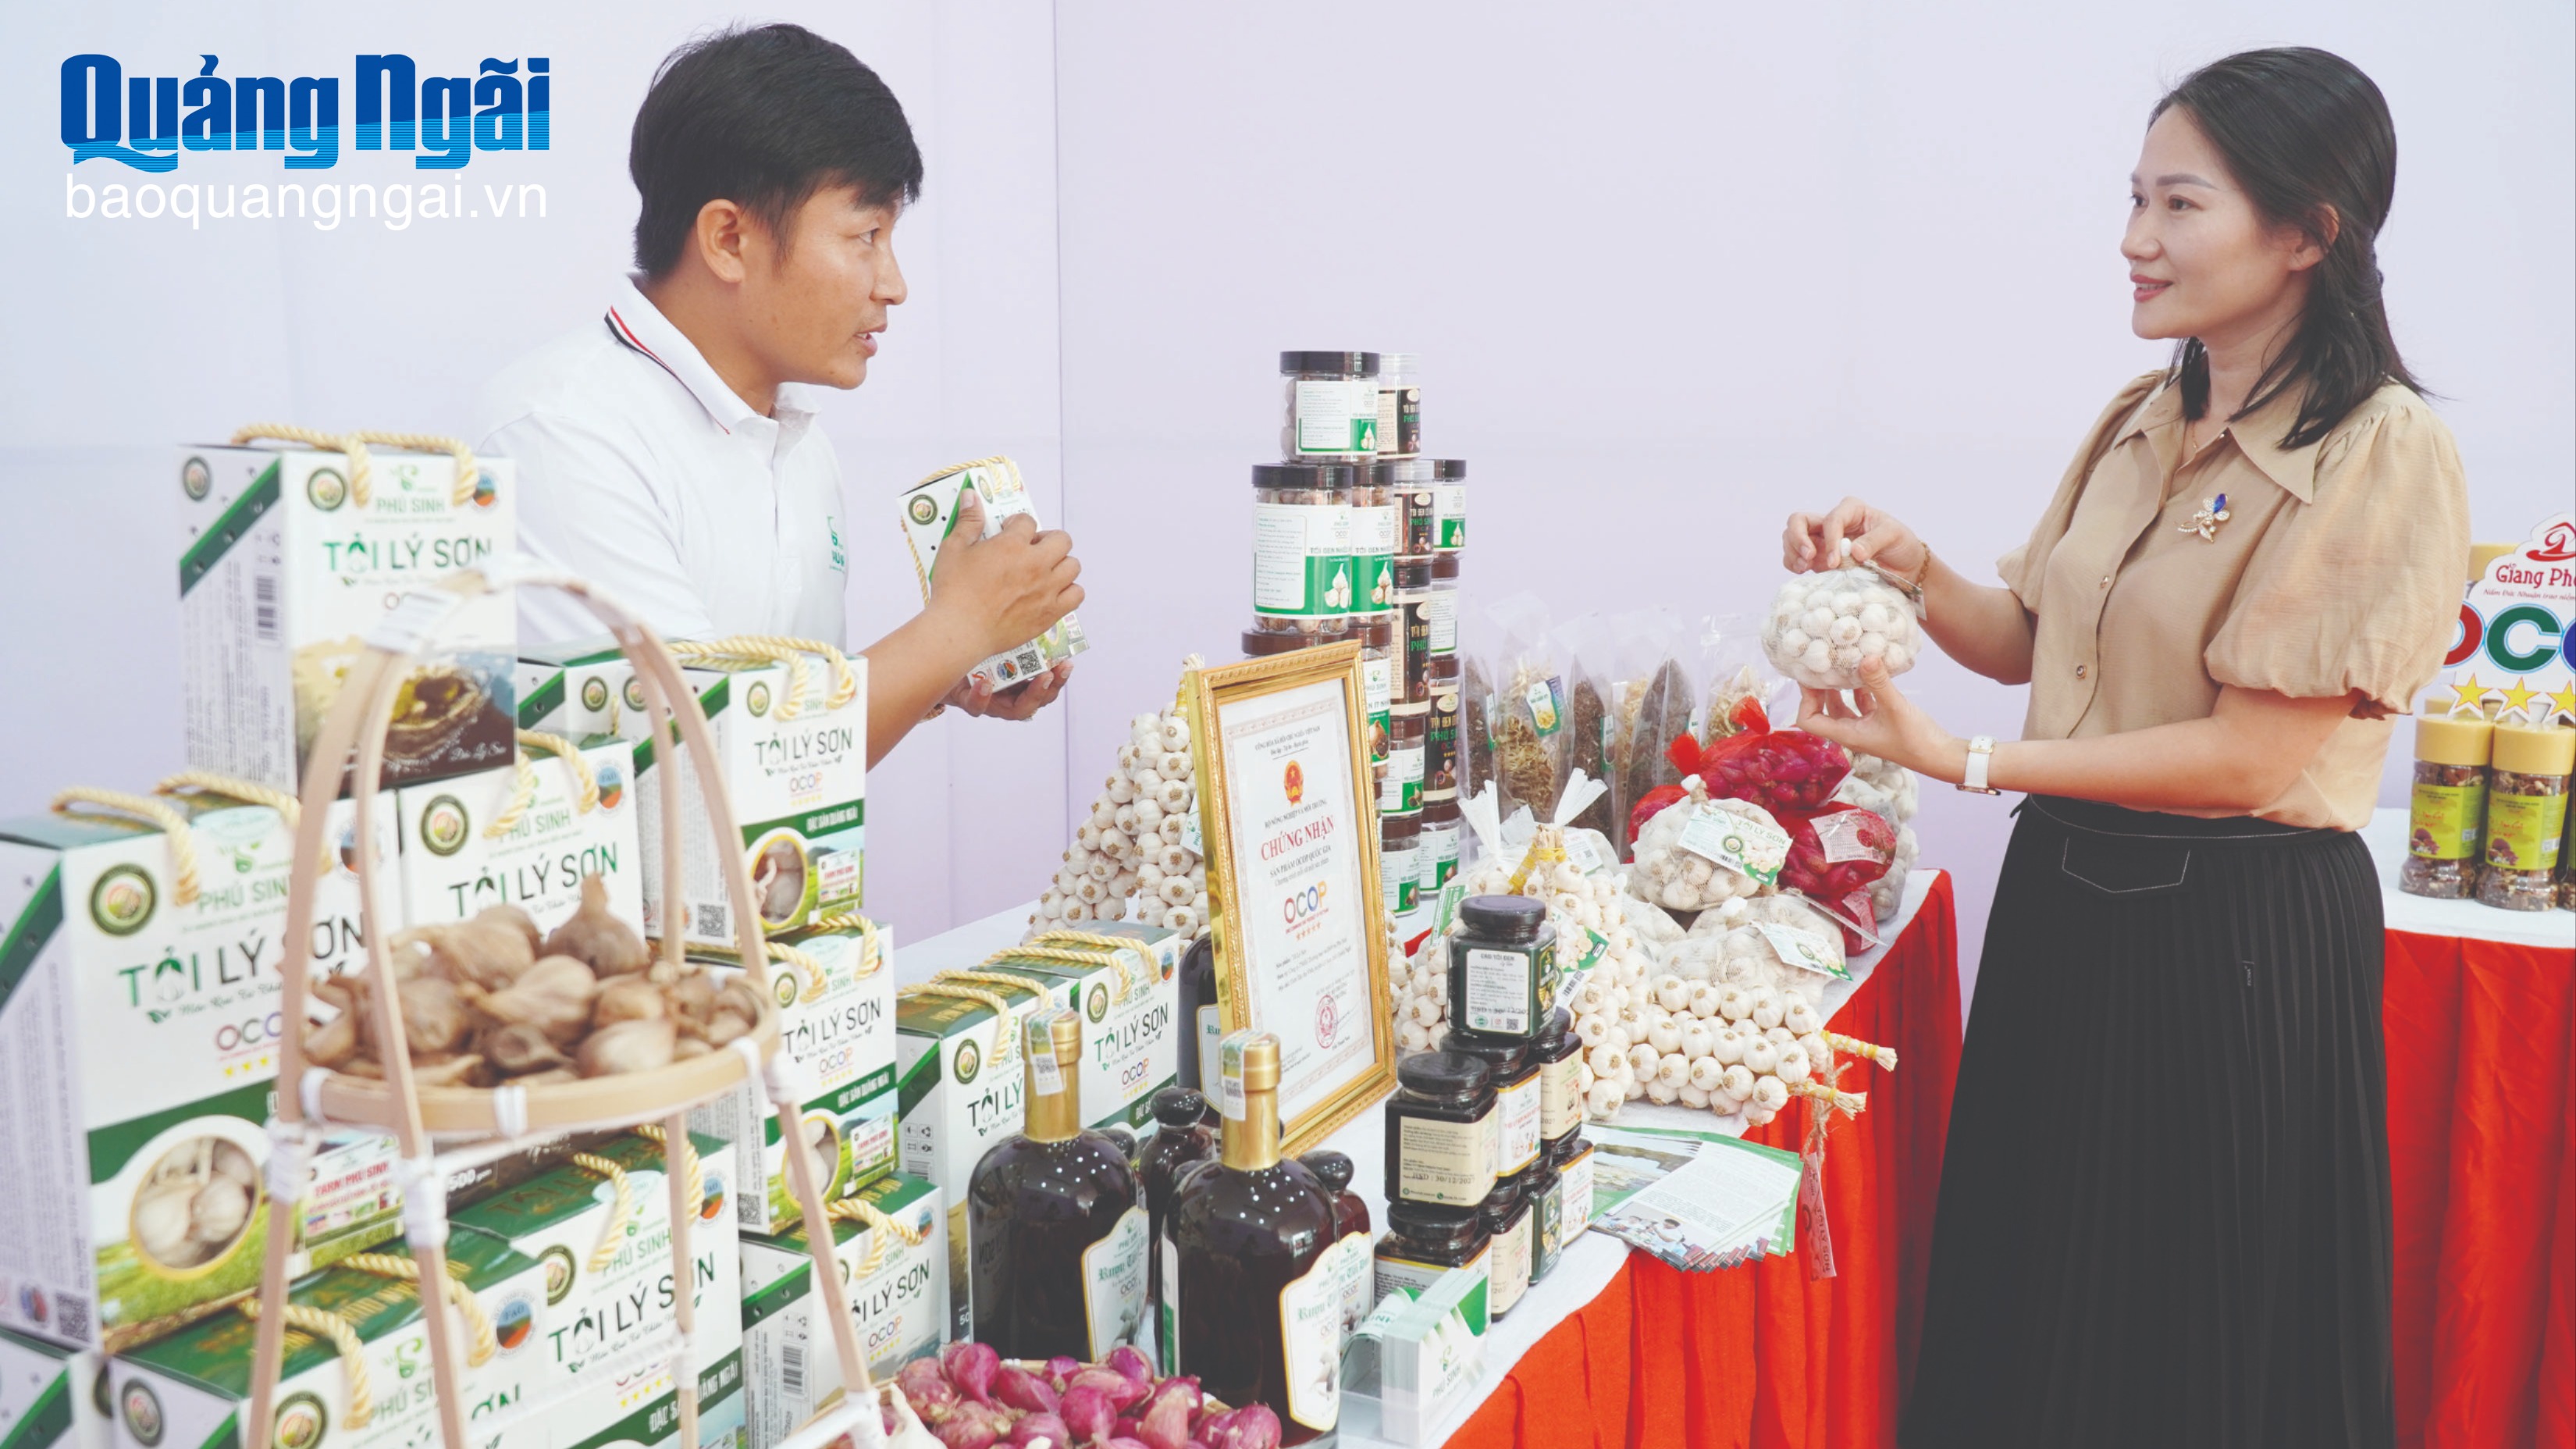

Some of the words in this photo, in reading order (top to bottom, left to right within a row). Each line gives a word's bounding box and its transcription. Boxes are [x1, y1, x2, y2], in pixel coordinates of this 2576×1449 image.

[411, 497, 446, 513] SINH
[390, 532, 424, 570] LÝ
[2496, 563, 2545, 589] Giang
[2548, 568, 2576, 587] Ph
[804, 697, 824, 712] SINH
[793, 728, 812, 759] LÝ
[817, 726, 852, 755] SƠN
[789, 771, 823, 792] OCOP
[535, 808, 571, 835] SINH
[1261, 828, 1303, 861] CHỨNG
[1304, 814, 1336, 844] NHẬN
[518, 853, 550, 901] LÝ
[561, 842, 618, 888] SƠN
[197, 880, 244, 913] PHÚ
[252, 876, 288, 903] SIN
[1283, 880, 1327, 924] OCOP
[117, 944, 201, 1008] TỎI
[217, 927, 267, 985] LÝ
[831, 976, 852, 992] SINH
[1134, 981, 1151, 1002] SINH
[216, 1011, 283, 1052] OCO
[821, 1007, 841, 1041] LÝ
[846, 997, 881, 1031] SƠN
[1094, 1027, 1119, 1063] TỎI
[1124, 1016, 1140, 1048] LÝ
[1142, 1002, 1169, 1038] SƠN
[819, 1046, 853, 1073] OCOP
[1122, 1057, 1150, 1085] OCOP
[966, 1087, 999, 1128] TỎI
[1004, 1072, 1023, 1110] LÝ
[448, 1169, 476, 1192] 500
[637, 1226, 673, 1259] SINH
[885, 1247, 905, 1266] SINH
[548, 1306, 605, 1363] TỎI
[616, 1280, 649, 1333] LÝ
[658, 1251, 716, 1309] SN
[852, 1299, 866, 1328] ỎI
[873, 1280, 892, 1315] LÝ
[897, 1259, 930, 1300] SƠN
[868, 1315, 902, 1348] OCOP
[415, 1377, 433, 1403] SI
[649, 1404, 669, 1434] ĐẶC
[698, 1374, 718, 1404] UẢNG
[718, 1360, 738, 1389] NGÃI
